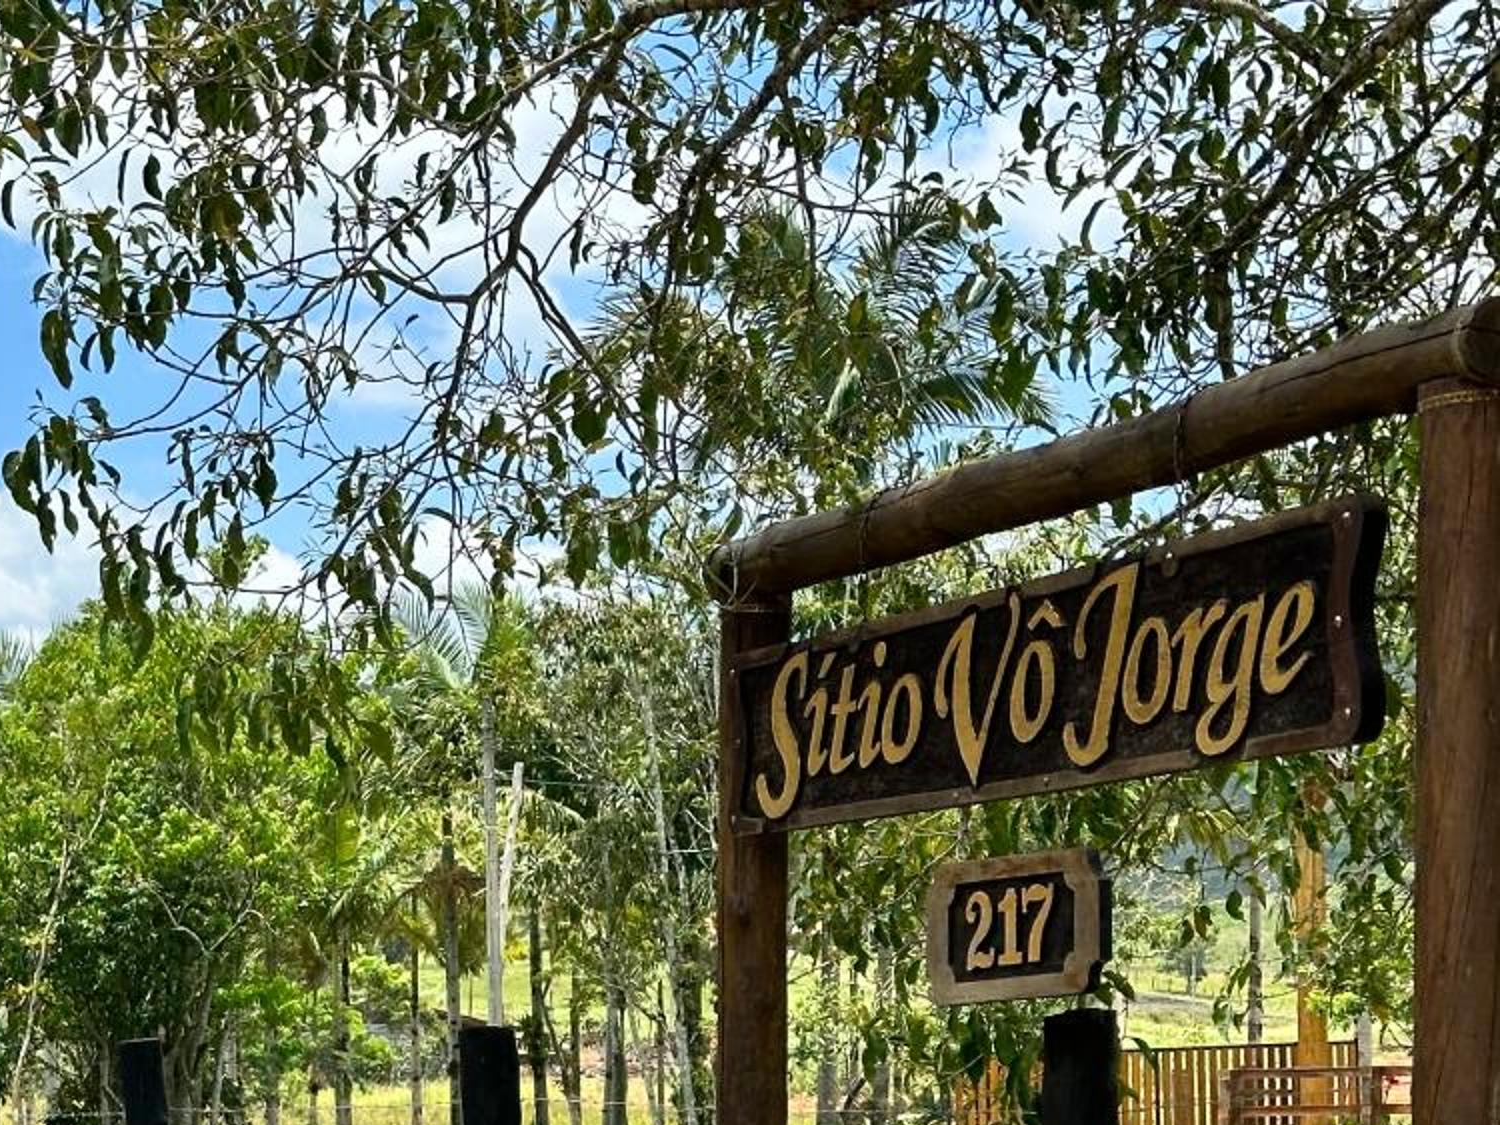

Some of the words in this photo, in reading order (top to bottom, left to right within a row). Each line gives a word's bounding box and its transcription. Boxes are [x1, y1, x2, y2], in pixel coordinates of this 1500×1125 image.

[755, 641, 923, 819] Sítio
[935, 595, 1066, 785] Vô
[1063, 563, 1315, 767] Jorge
[966, 882, 1054, 971] 217
